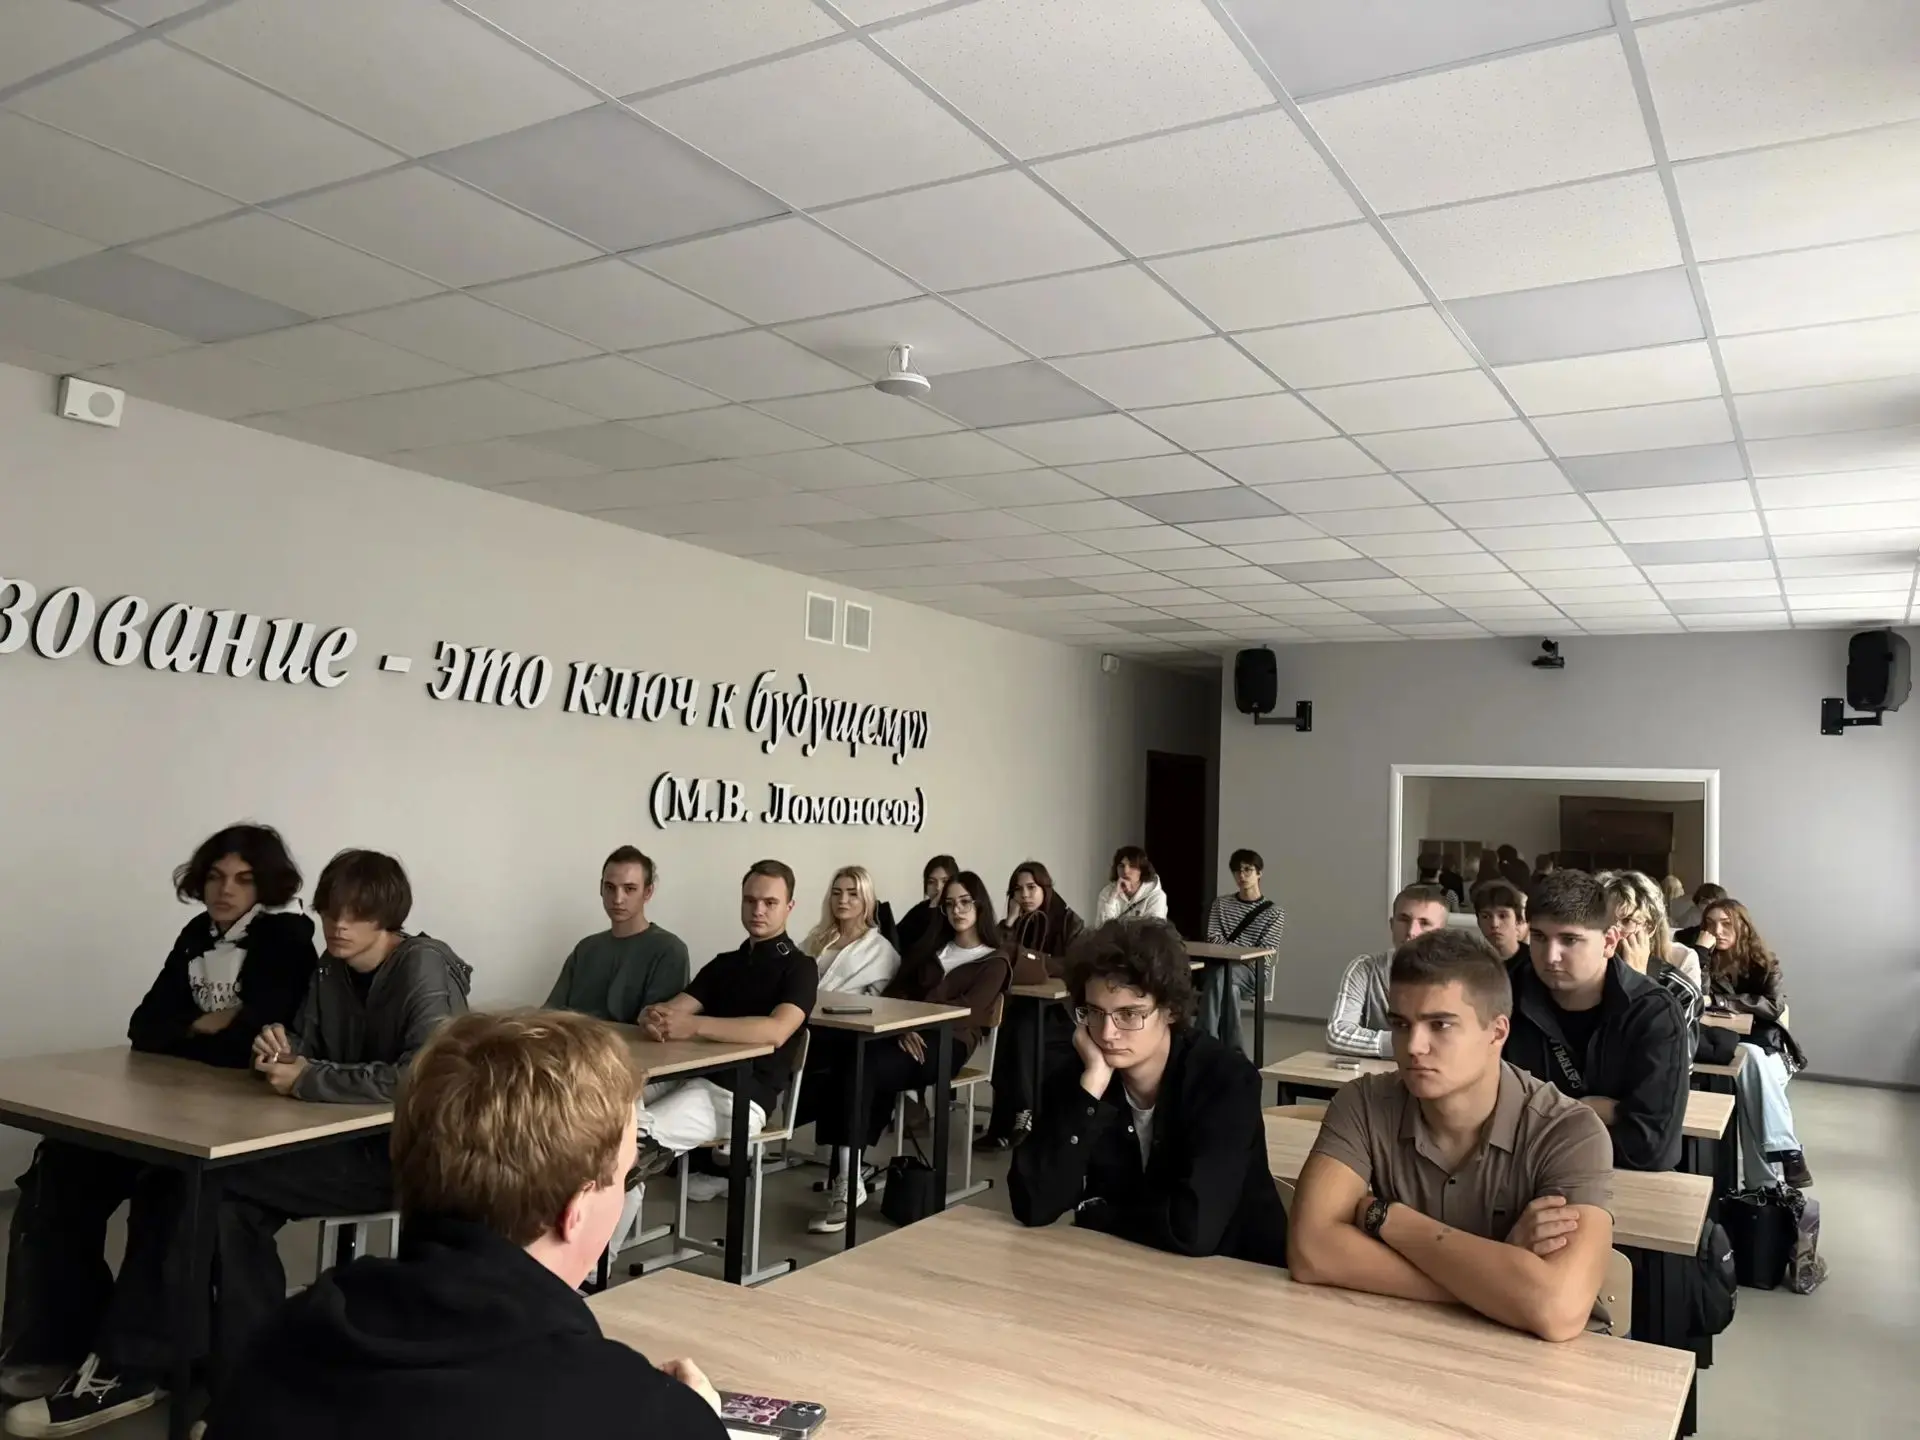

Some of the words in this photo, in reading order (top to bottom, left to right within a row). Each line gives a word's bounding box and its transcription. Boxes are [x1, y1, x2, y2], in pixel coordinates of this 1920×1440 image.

[0, 576, 358, 688] зование
[426, 640, 553, 709] это
[563, 660, 701, 726] ключ
[708, 682, 740, 729] к
[745, 669, 931, 765] будущему»
[649, 771, 753, 829] (М.В.
[760, 781, 928, 832] Ломоносов)
